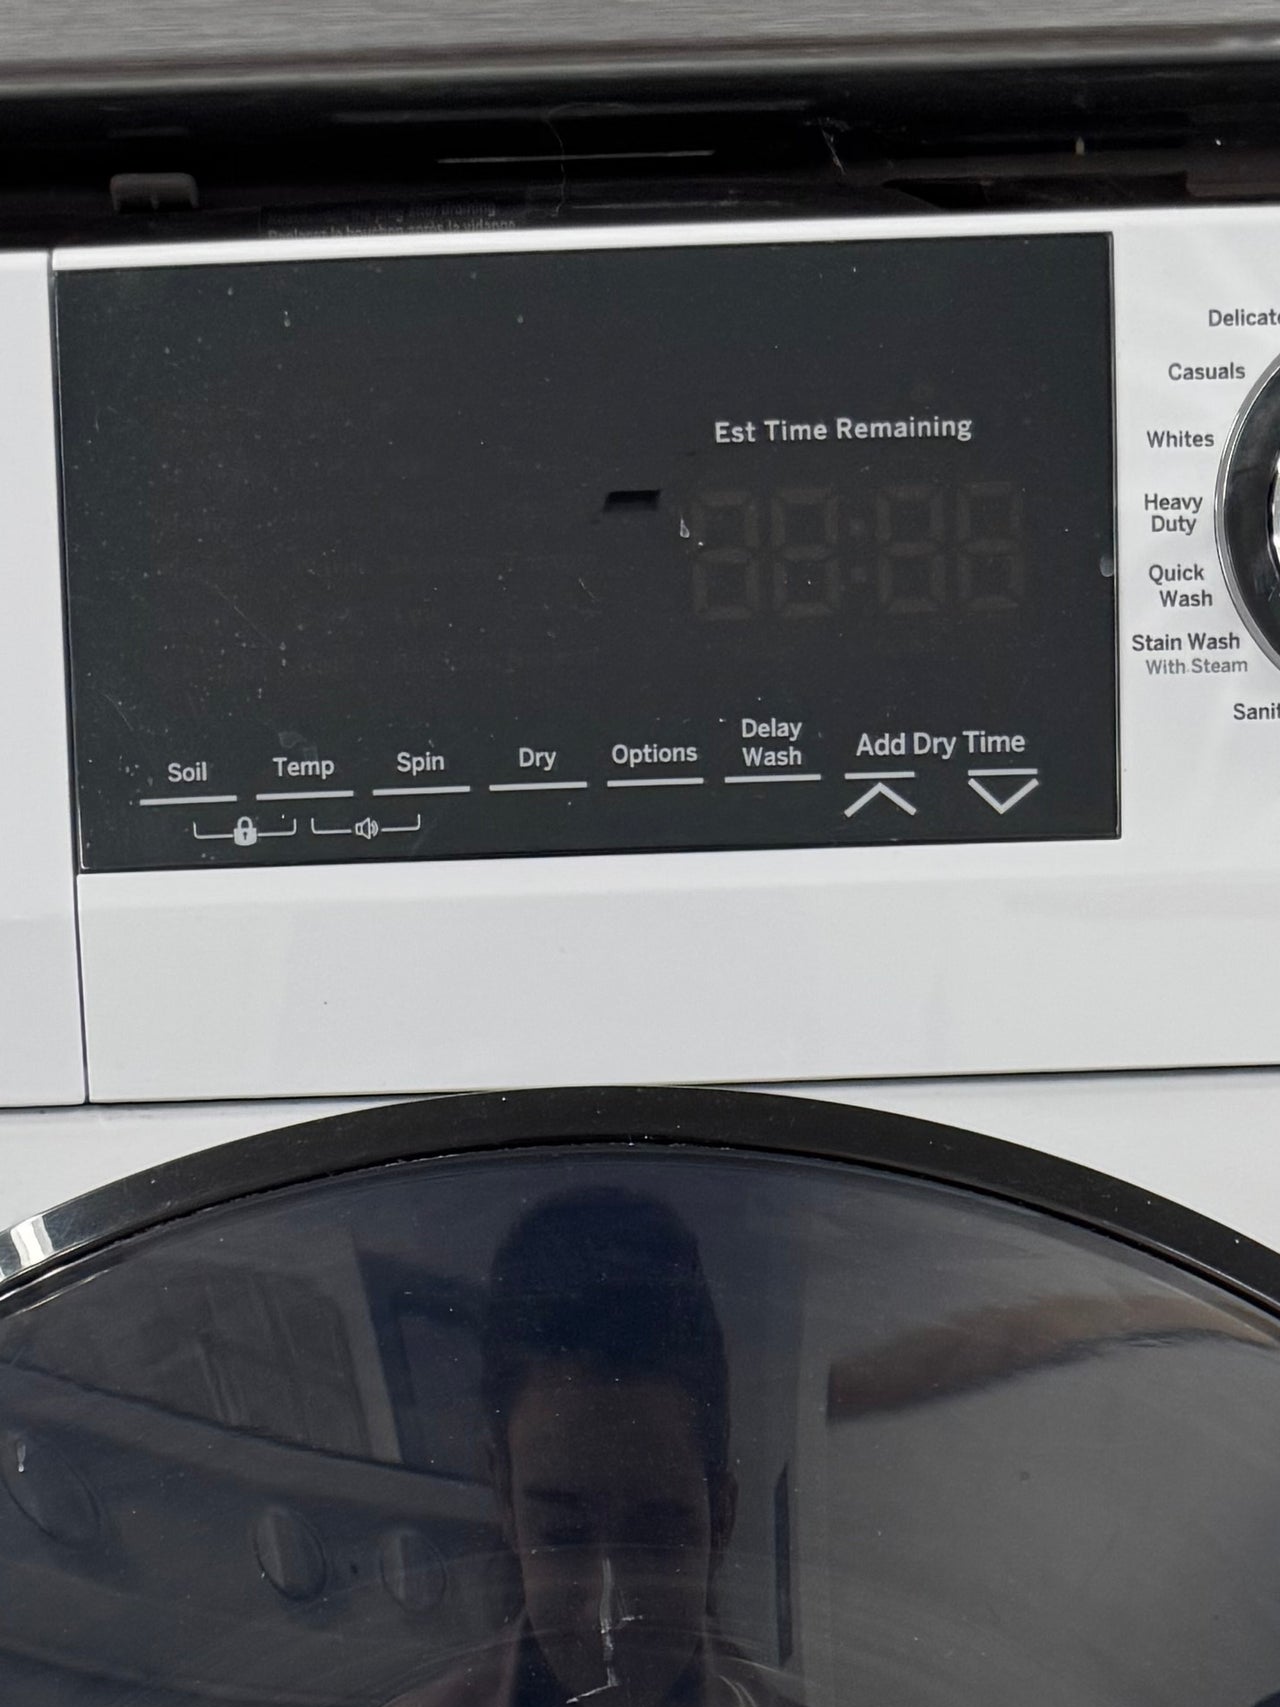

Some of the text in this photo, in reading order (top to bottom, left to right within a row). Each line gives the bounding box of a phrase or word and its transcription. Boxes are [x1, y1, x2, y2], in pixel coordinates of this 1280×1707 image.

[1169, 362, 1245, 380] Casuals
[715, 416, 972, 444] Est Time Remaining
[1147, 431, 1214, 448] Whites
[1145, 493, 1203, 515] Heavy
[1152, 516, 1196, 536] Duty
[1149, 564, 1204, 585] Quick
[1160, 590, 1212, 607] Wash
[1133, 632, 1240, 651] Stain Wash
[1146, 658, 1247, 674] With Steam
[742, 718, 802, 741] Delay
[856, 731, 1025, 759] Add Dry Time
[397, 752, 444, 776] Spin
[519, 748, 556, 771] Dry
[612, 744, 697, 768] Options
[742, 746, 801, 766] Wash
[168, 762, 207, 782] Soil
[273, 757, 334, 779] Temp
